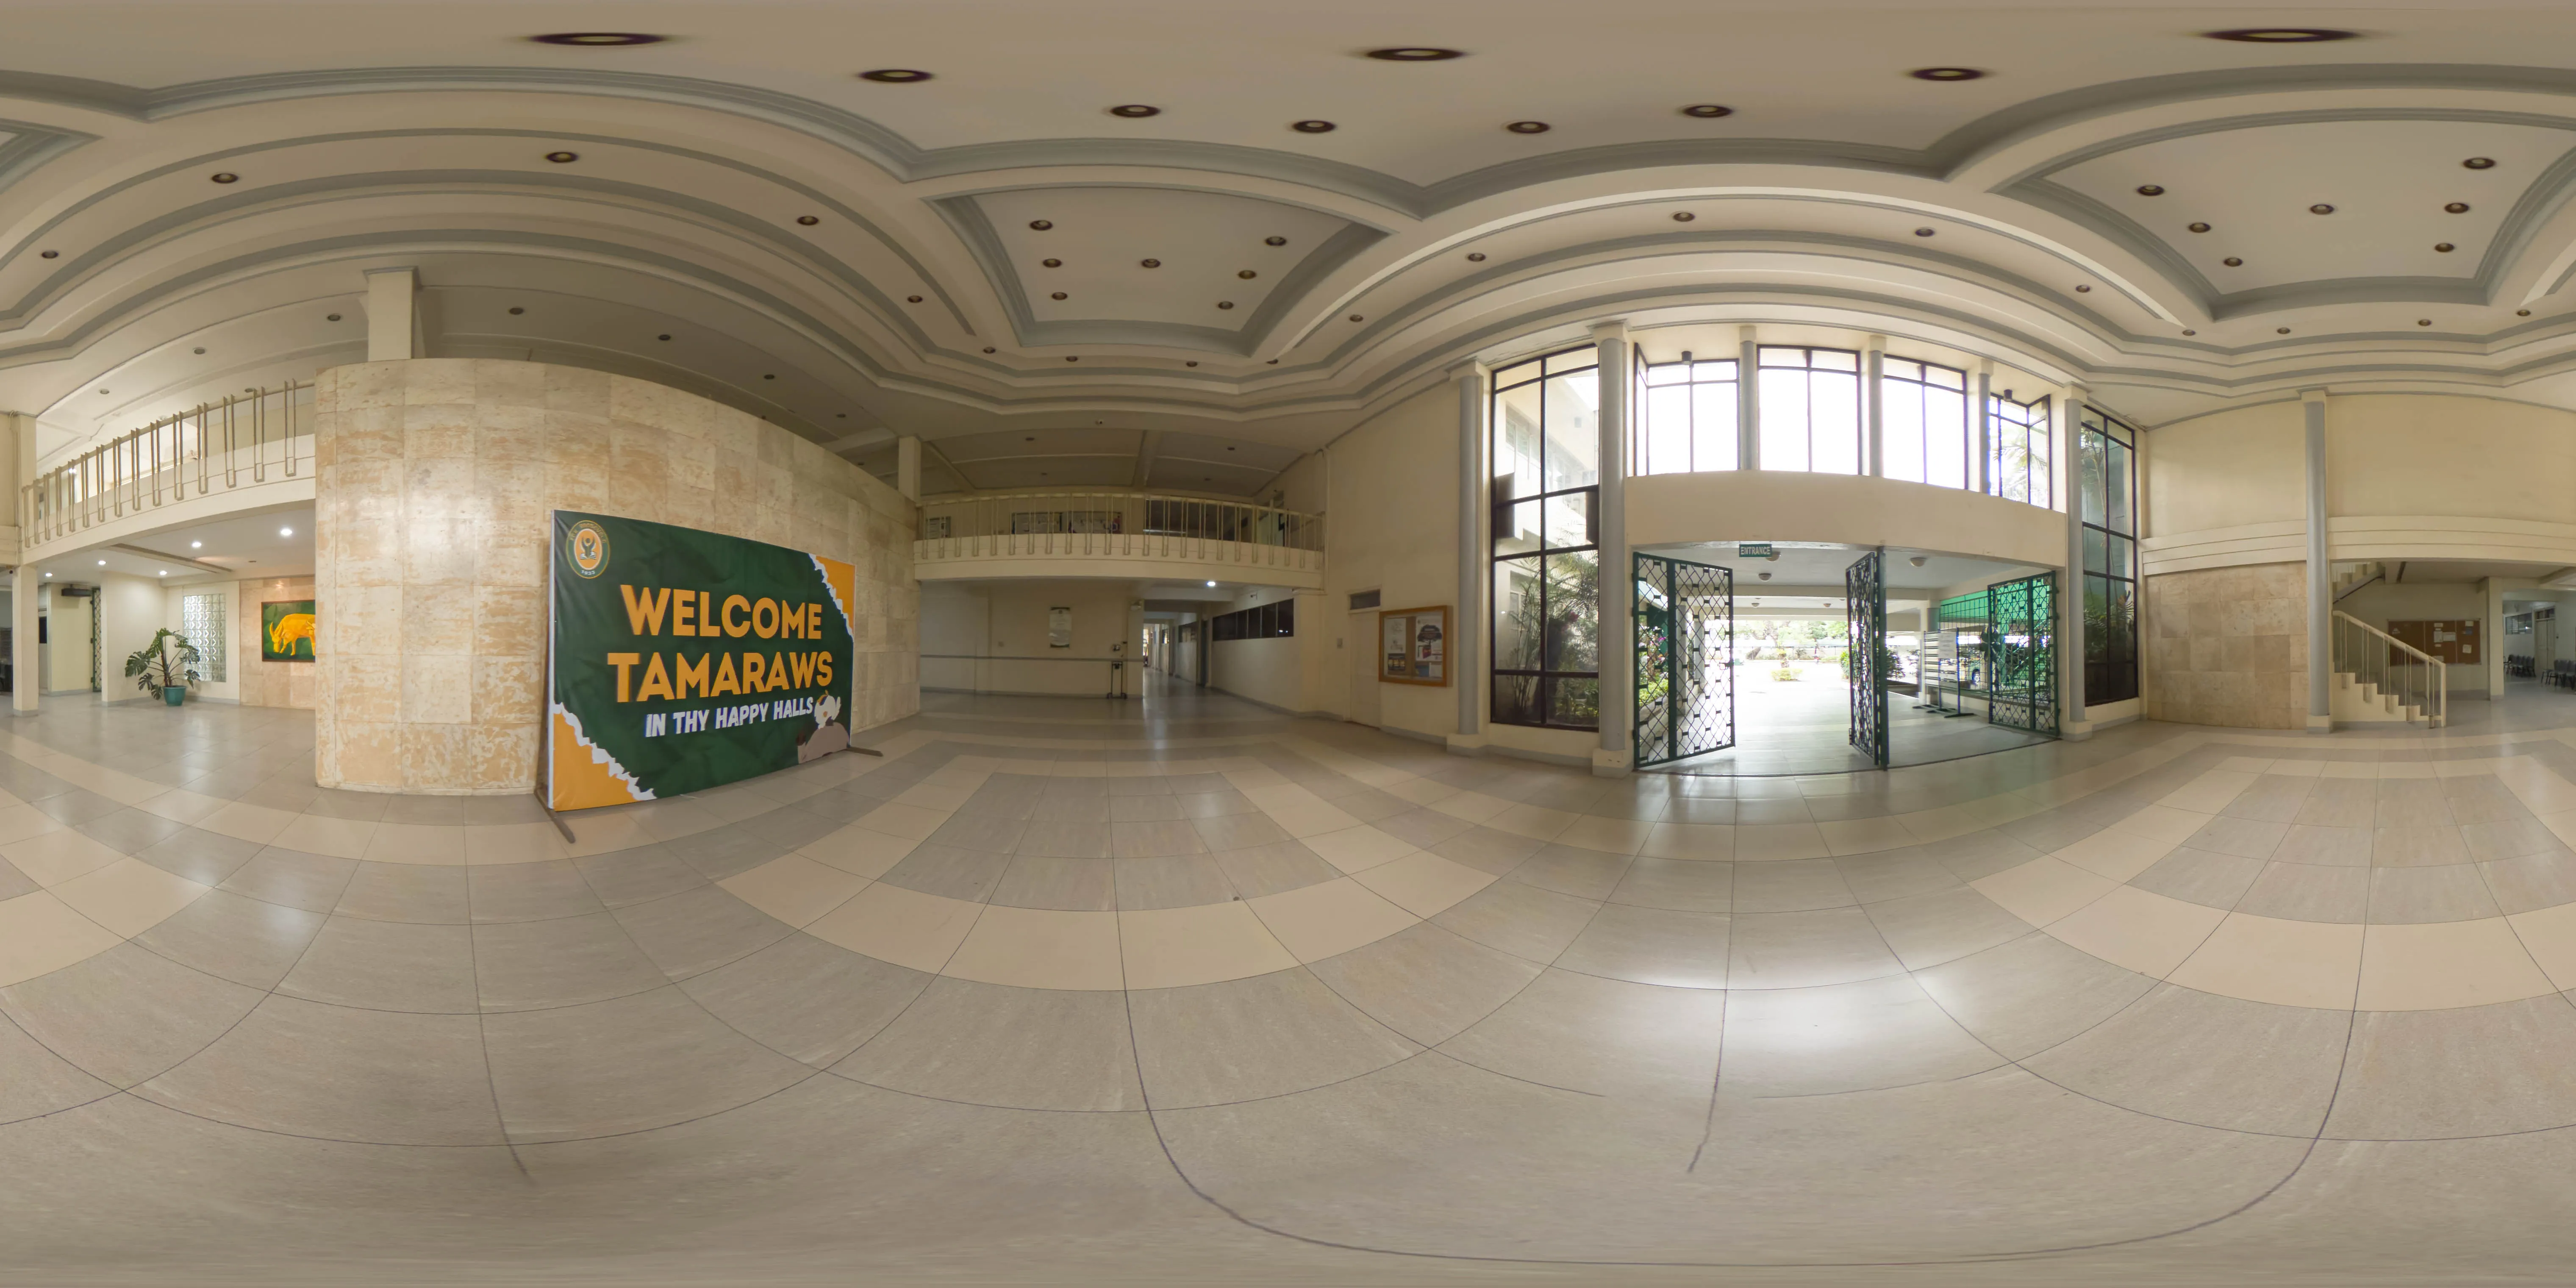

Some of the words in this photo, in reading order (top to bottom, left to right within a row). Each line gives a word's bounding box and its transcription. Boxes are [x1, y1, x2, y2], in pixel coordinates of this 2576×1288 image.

[1740, 547, 1771, 555] ENTRANCE
[620, 584, 822, 639] WELCOME
[607, 651, 833, 702] TAMARAWS
[645, 713, 666, 737] IN
[673, 709, 710, 734] THY
[715, 702, 769, 729] HAPPY
[773, 697, 813, 720] HALLS
